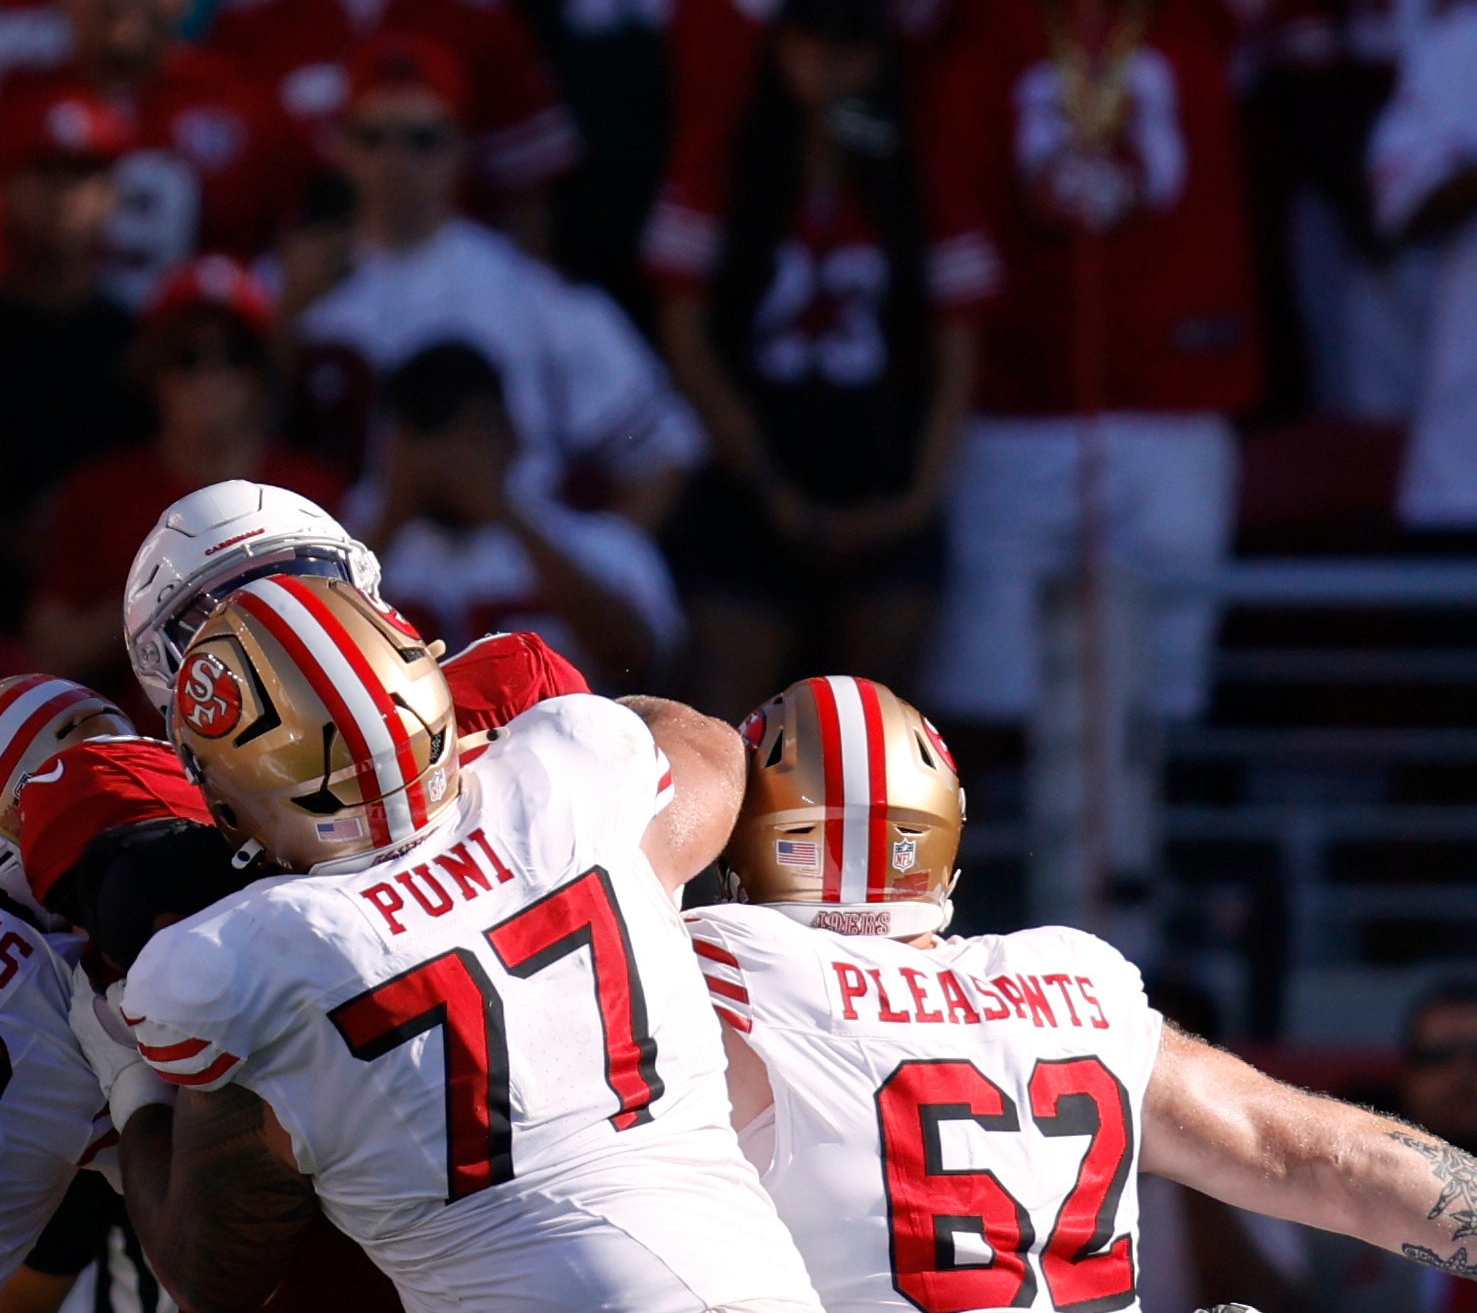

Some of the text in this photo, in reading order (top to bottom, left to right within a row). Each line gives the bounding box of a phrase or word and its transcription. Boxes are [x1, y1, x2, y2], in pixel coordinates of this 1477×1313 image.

[359, 827, 517, 936] PUNI
[812, 910, 891, 936] 49ERS
[326, 863, 666, 1206] 77
[831, 962, 1110, 1030] PLEASANTS
